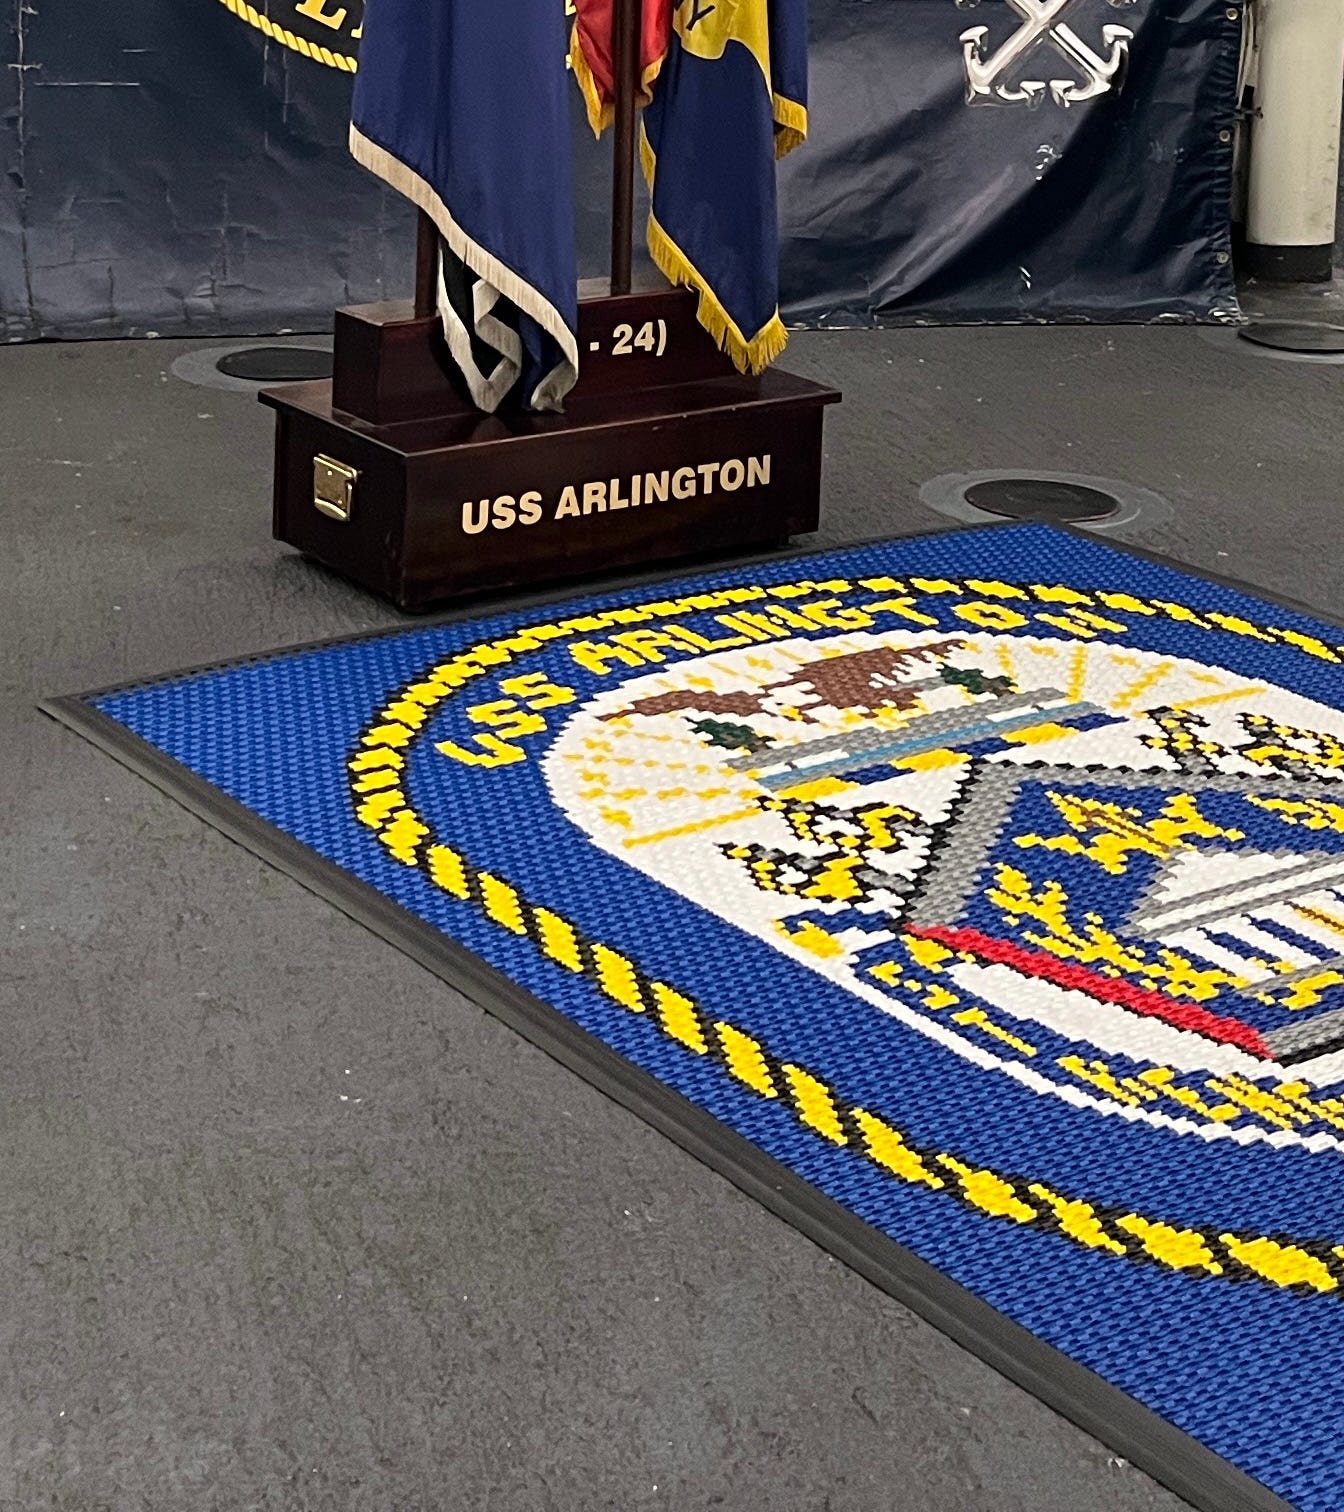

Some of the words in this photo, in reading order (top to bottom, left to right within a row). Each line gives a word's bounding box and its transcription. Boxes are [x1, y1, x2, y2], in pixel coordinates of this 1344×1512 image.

[612, 319, 667, 357] 24)
[462, 490, 543, 535] USS
[555, 454, 772, 521] ARLINGTON
[435, 671, 577, 769] USS
